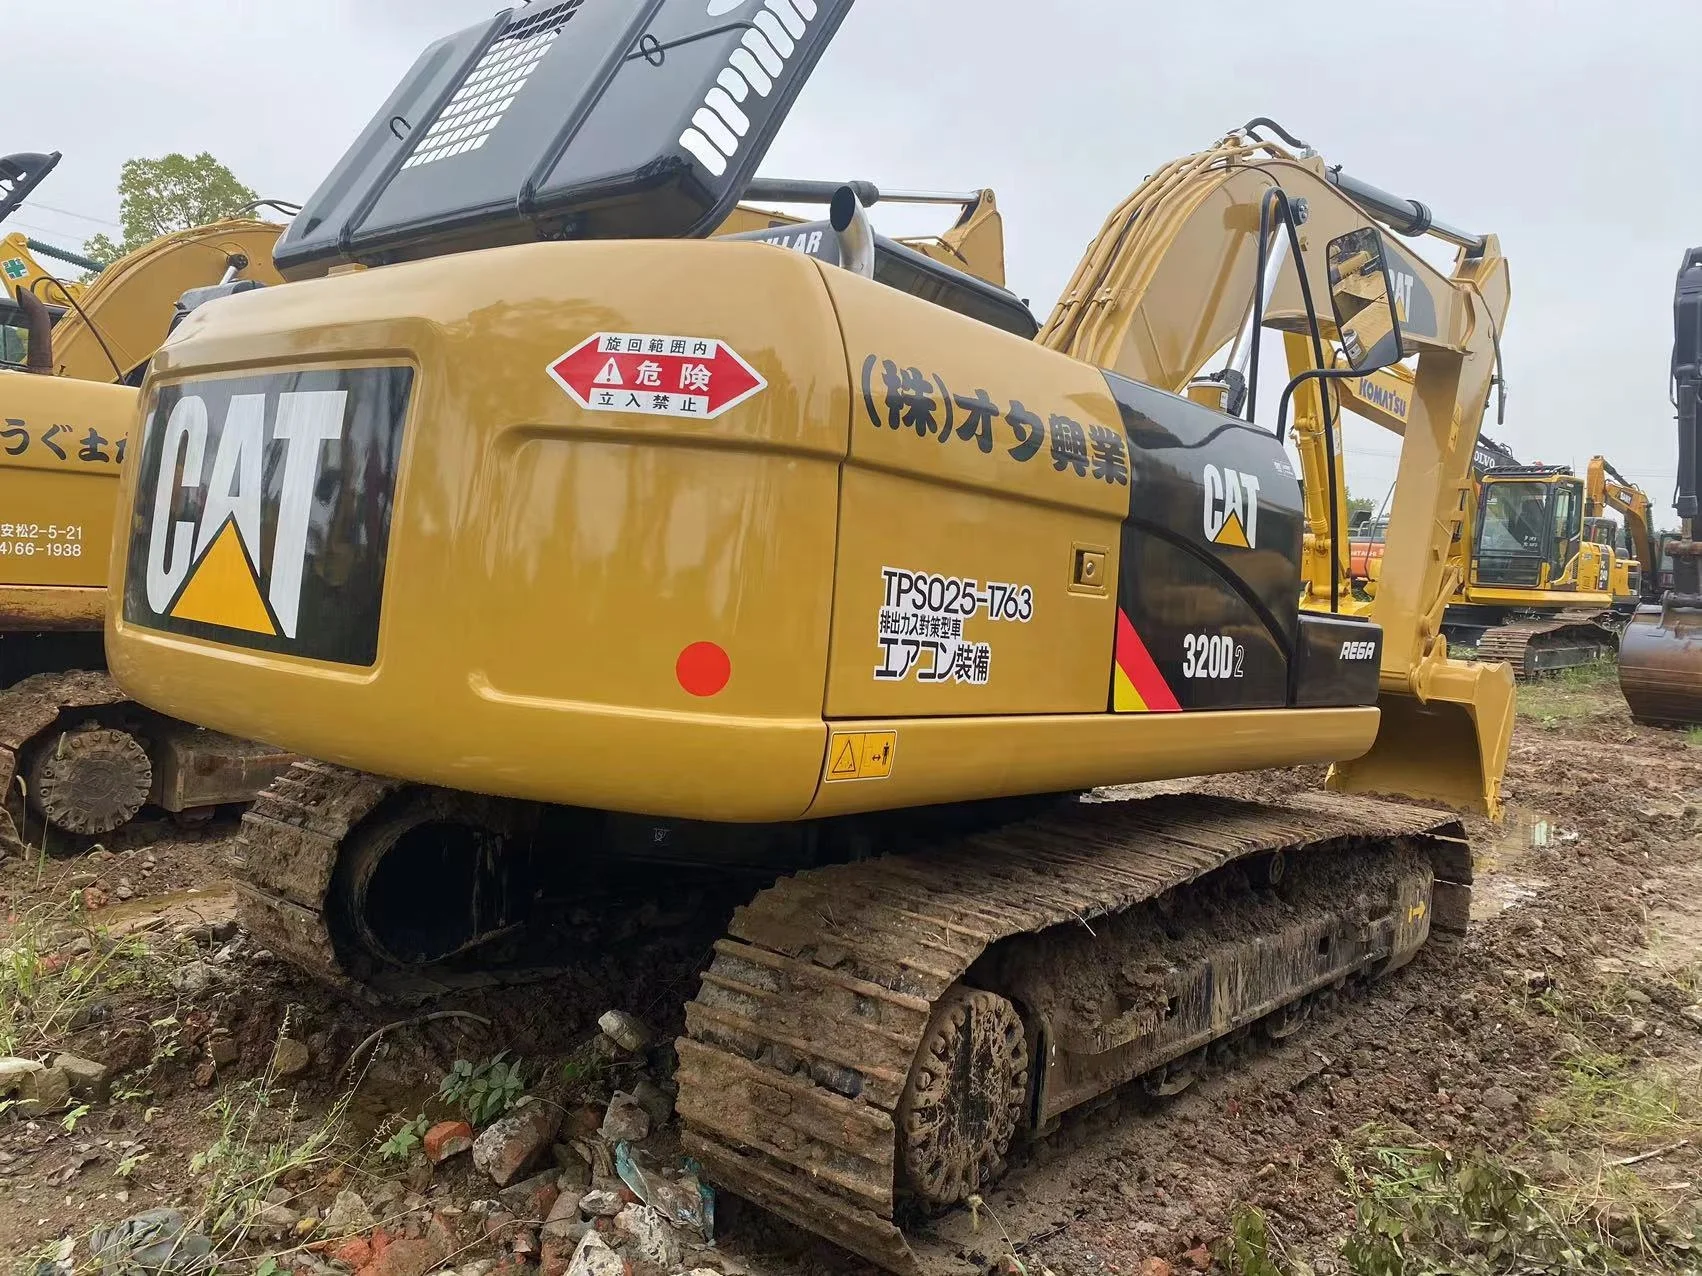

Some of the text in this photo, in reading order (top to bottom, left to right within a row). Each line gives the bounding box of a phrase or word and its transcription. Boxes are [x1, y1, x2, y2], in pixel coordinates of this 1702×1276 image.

[605, 336, 707, 356] 旋回範囲内
[635, 360, 712, 392] 危険
[598, 392, 697, 412] 立入禁止
[1359, 377, 1406, 418] KOMATSU
[1473, 451, 1496, 468] OLVO
[146, 390, 348, 639] CAT
[1203, 464, 1260, 549] CAT
[1, 523, 82, 540] 安松2-5-21
[883, 571, 1032, 620] TPS025-1763
[876, 637, 990, 682] エアコン装備
